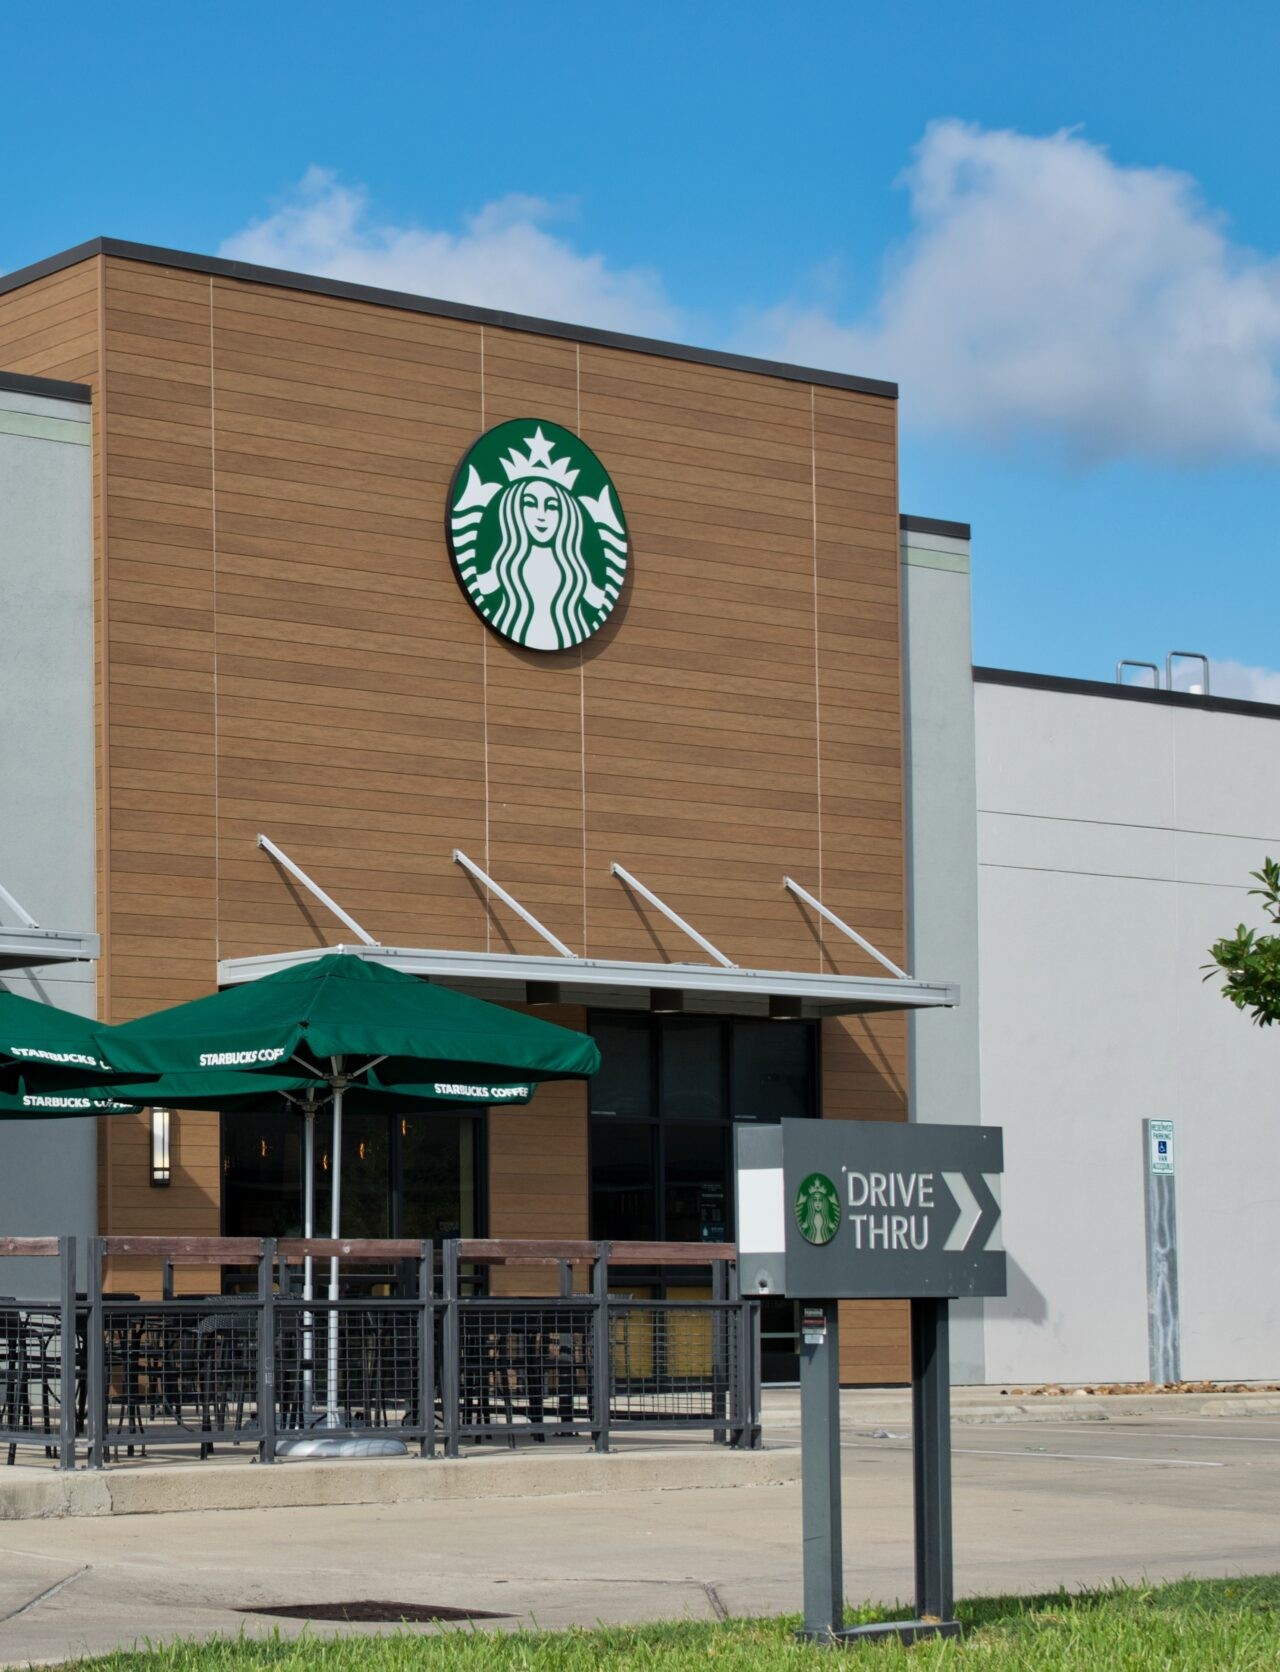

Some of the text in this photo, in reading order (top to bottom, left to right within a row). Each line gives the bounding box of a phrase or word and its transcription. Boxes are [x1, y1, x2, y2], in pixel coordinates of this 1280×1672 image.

[10, 1046, 97, 1066] STARBUCKS
[200, 1047, 285, 1066] STARBUCKS COFF
[434, 1083, 529, 1098] STARBUCKS COFFEE
[23, 1095, 91, 1108] STARBUCKS
[847, 1171, 934, 1208] DRIVE
[848, 1214, 929, 1250] THRU
